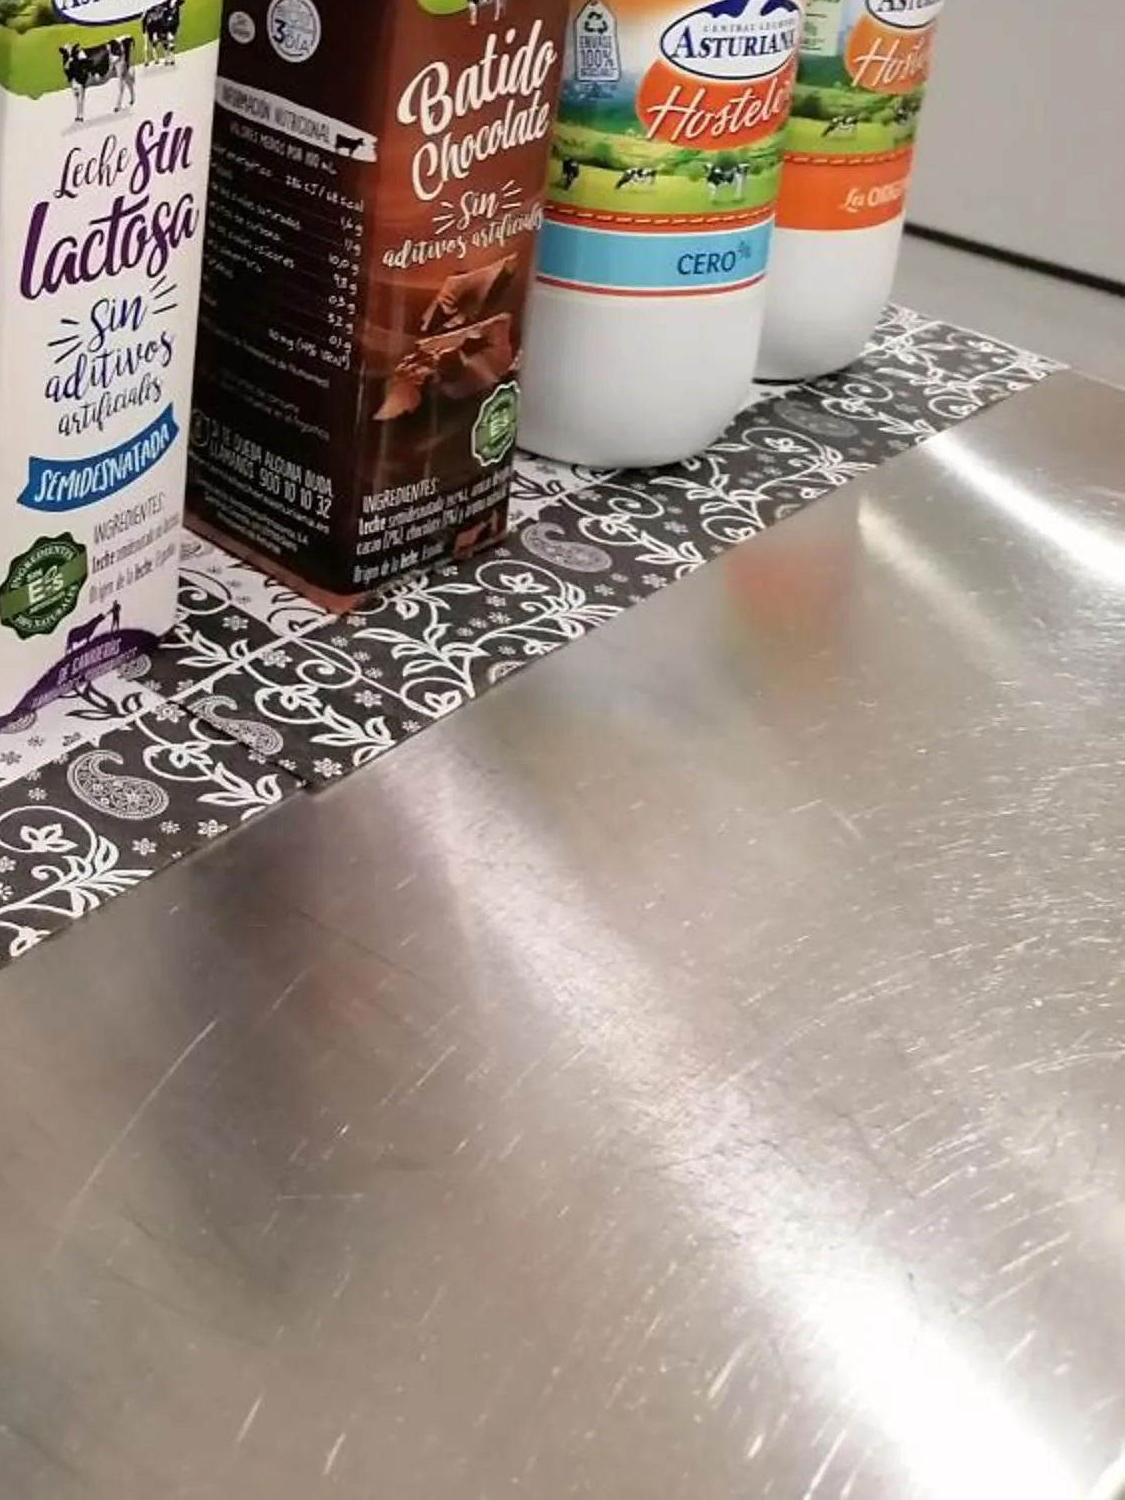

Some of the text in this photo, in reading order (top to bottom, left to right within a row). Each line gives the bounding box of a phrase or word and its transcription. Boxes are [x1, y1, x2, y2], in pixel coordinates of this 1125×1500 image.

[272, 18, 287, 45] 3
[579, 49, 615, 69] 100%
[702, 23, 757, 34] CENTRAL
[396, 19, 558, 137] Batido
[53, 132, 130, 200] Leche
[411, 88, 552, 202] Chocolate
[19, 192, 200, 302] lactosa
[381, 202, 545, 270] aditivos artificiales
[44, 329, 175, 404] aditivos
[56, 370, 163, 437] artificiales
[34, 422, 172, 503] SEMIDESNATADA
[258, 466, 281, 496] 900
[284, 479, 297, 503] 10
[299, 486, 312, 511] 10
